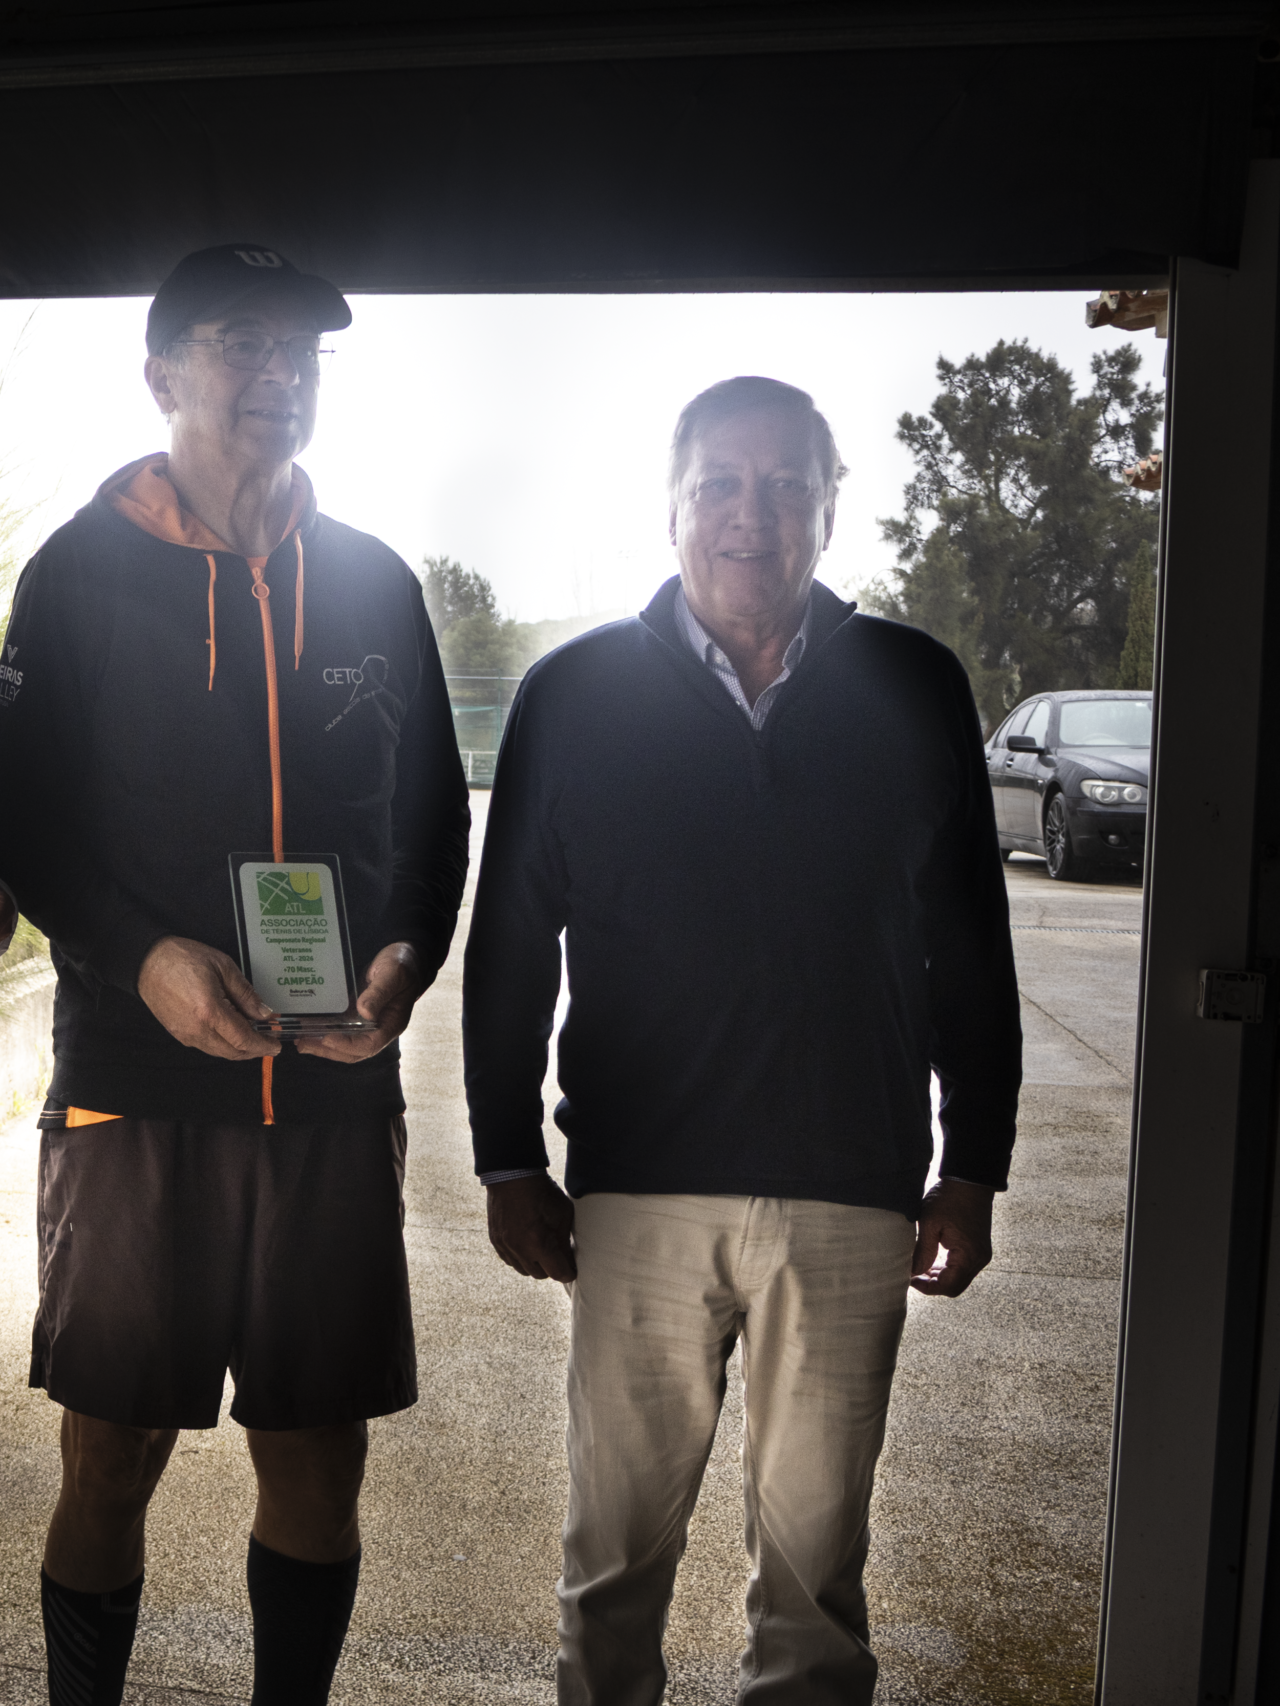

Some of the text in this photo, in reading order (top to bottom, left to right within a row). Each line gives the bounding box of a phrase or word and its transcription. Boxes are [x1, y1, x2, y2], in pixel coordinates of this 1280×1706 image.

[323, 668, 364, 684] CETO
[285, 902, 306, 913] ATL
[260, 918, 328, 928] ASSOCIAÇÃO
[301, 937, 326, 945] Regional
[277, 974, 325, 985] CAMPEÃO
